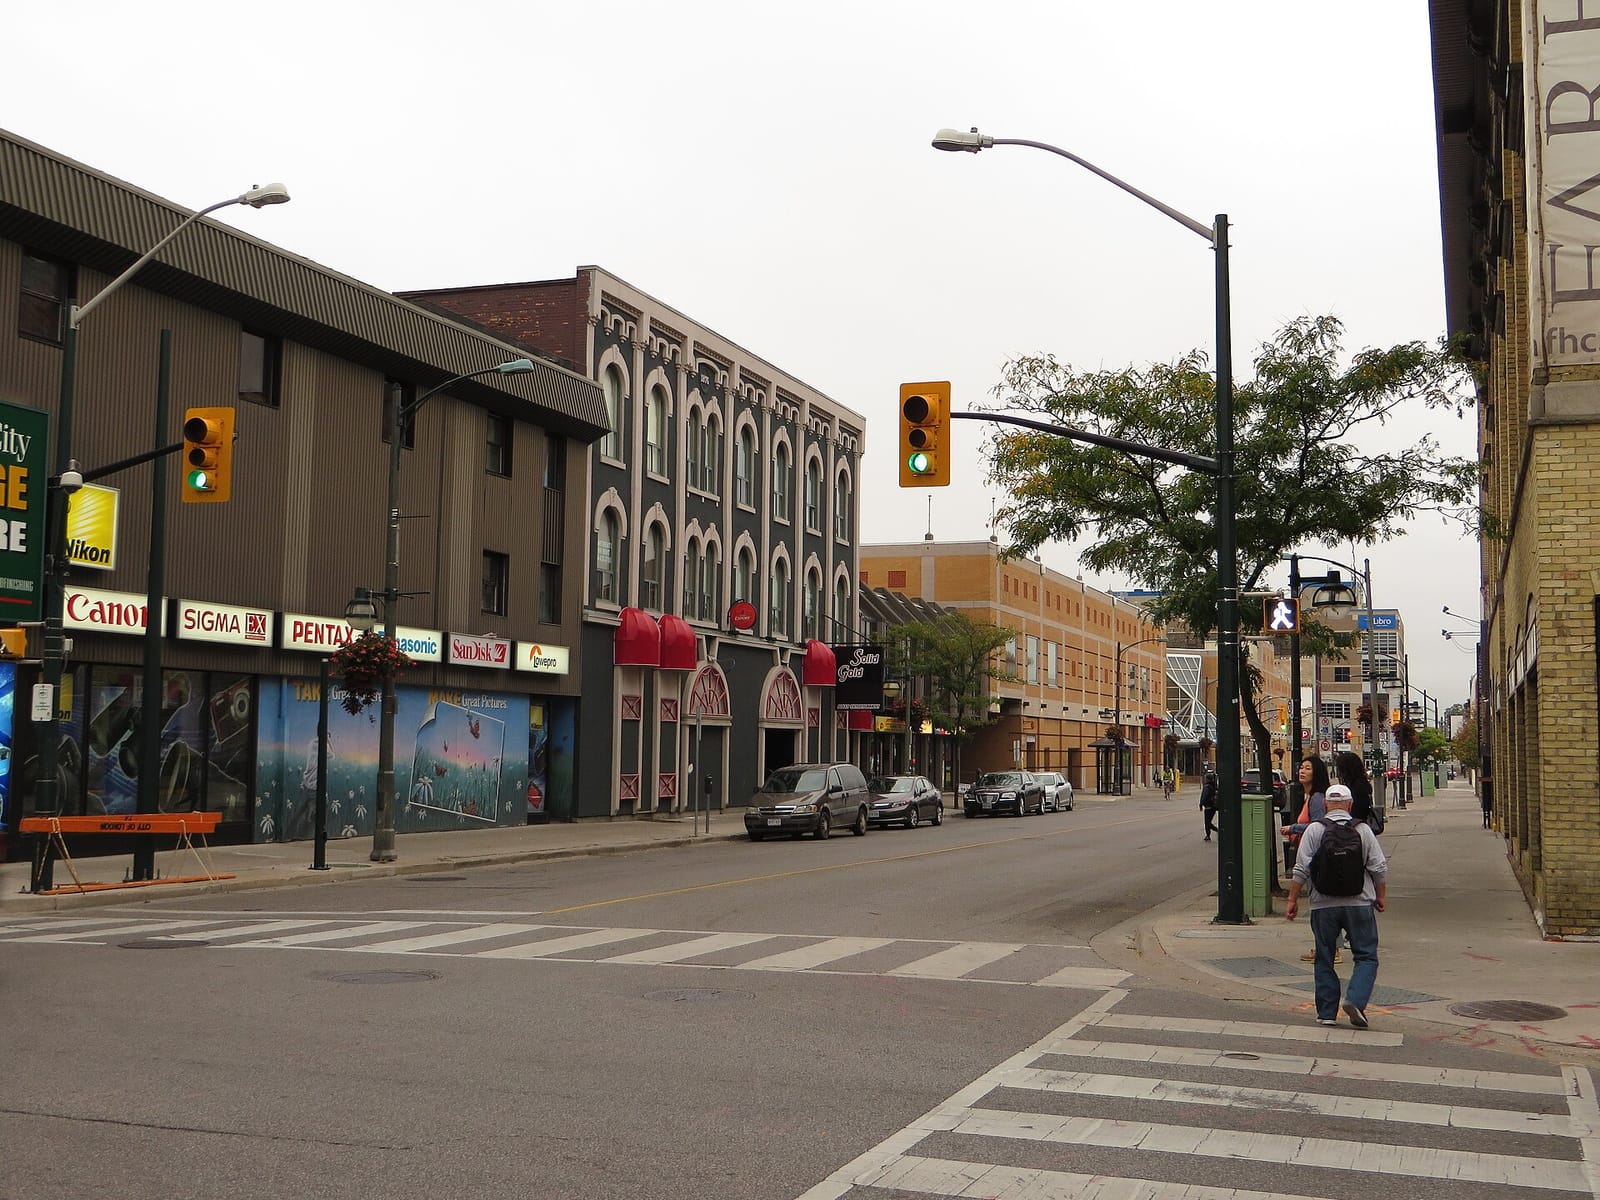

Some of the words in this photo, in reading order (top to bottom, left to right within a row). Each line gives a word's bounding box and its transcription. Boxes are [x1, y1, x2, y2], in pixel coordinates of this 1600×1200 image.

[0, 422, 32, 463] ity
[184, 608, 241, 634] SIGMA
[246, 613, 266, 635] EX
[1372, 616, 1392, 625] Libro
[292, 620, 354, 647] PENTAX
[452, 639, 493, 662] SanDisk
[849, 648, 880, 667] Solid
[533, 655, 557, 669] Lowepro
[837, 664, 864, 683] Gold
[293, 679, 329, 703] TAK
[462, 693, 481, 708] Great
[481, 694, 508, 710] Pictures
